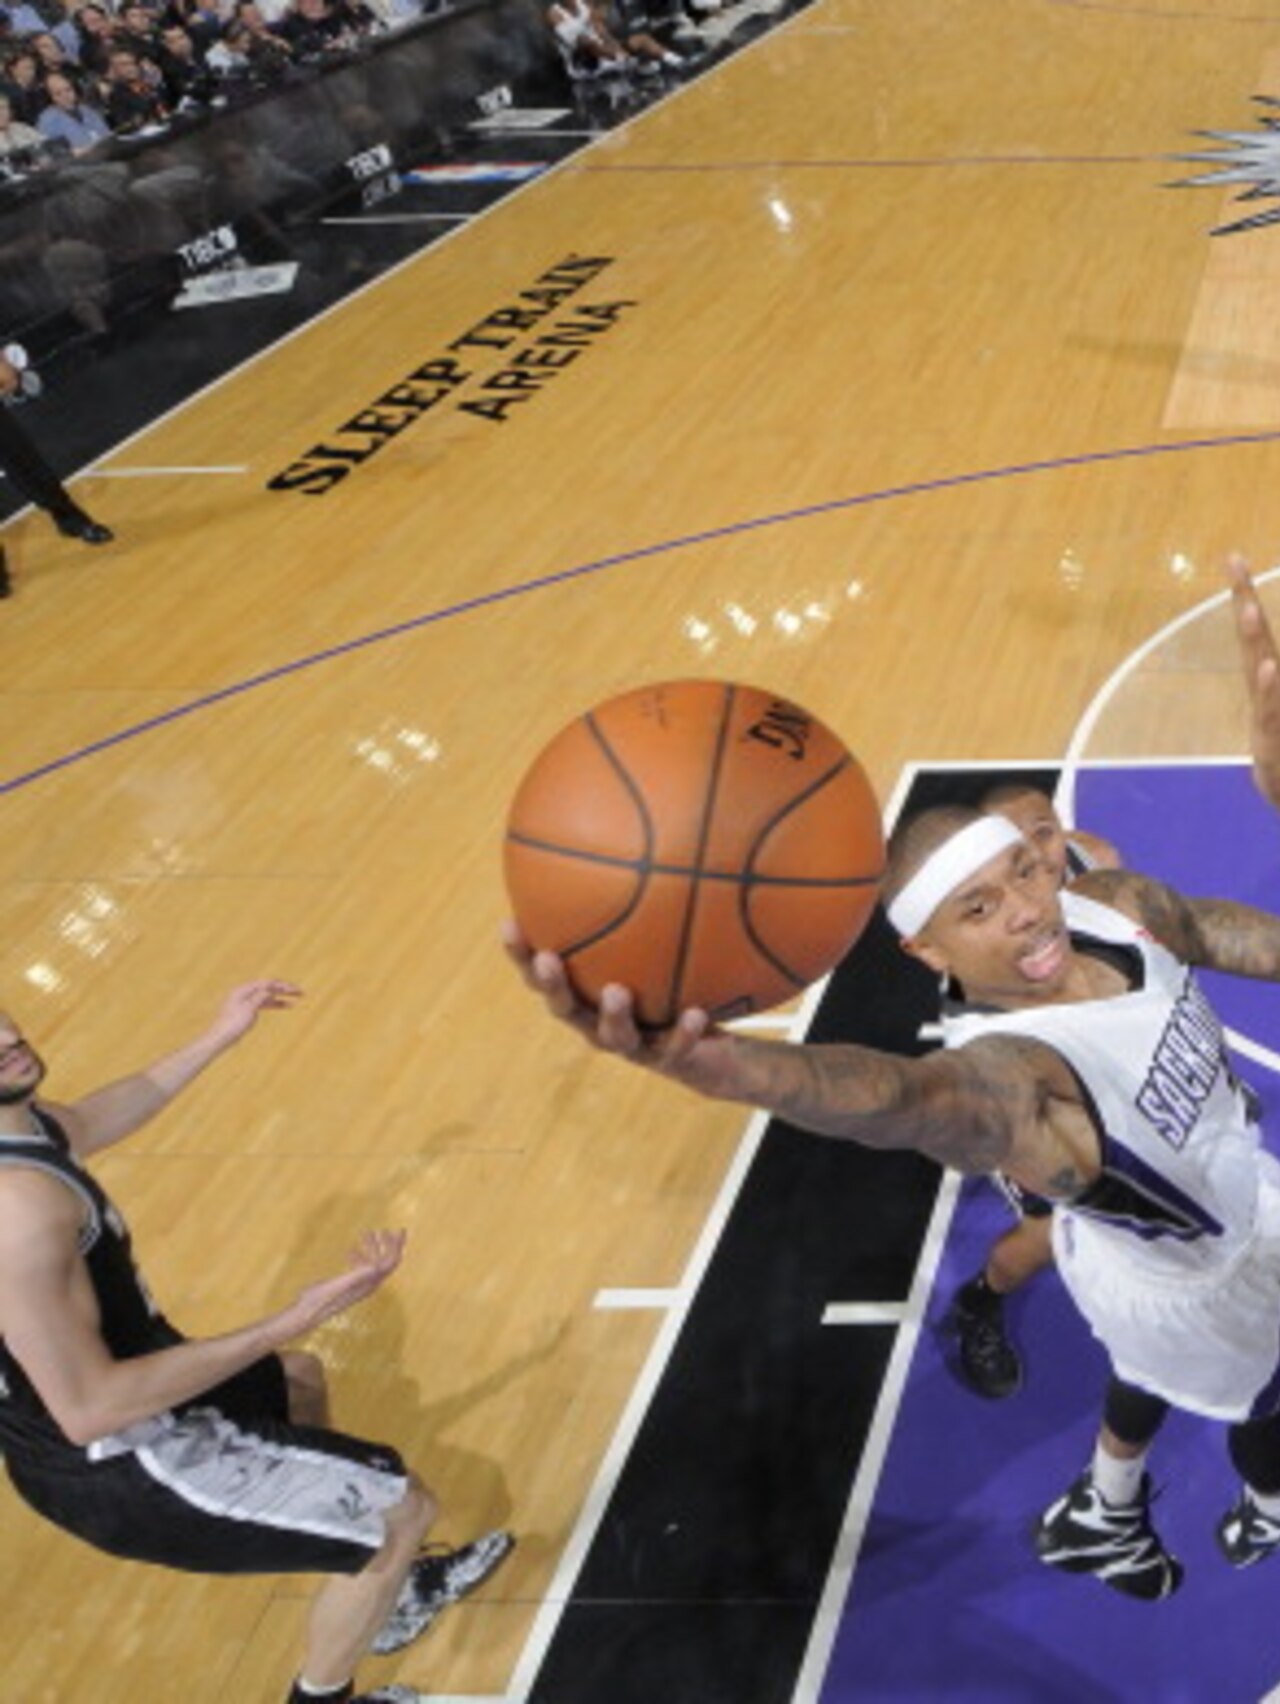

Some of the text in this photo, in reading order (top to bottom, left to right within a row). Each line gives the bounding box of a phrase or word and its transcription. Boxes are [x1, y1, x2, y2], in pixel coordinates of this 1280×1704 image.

[266, 253, 616, 495] SLEEP TRAIN
[456, 300, 639, 423] ARENA
